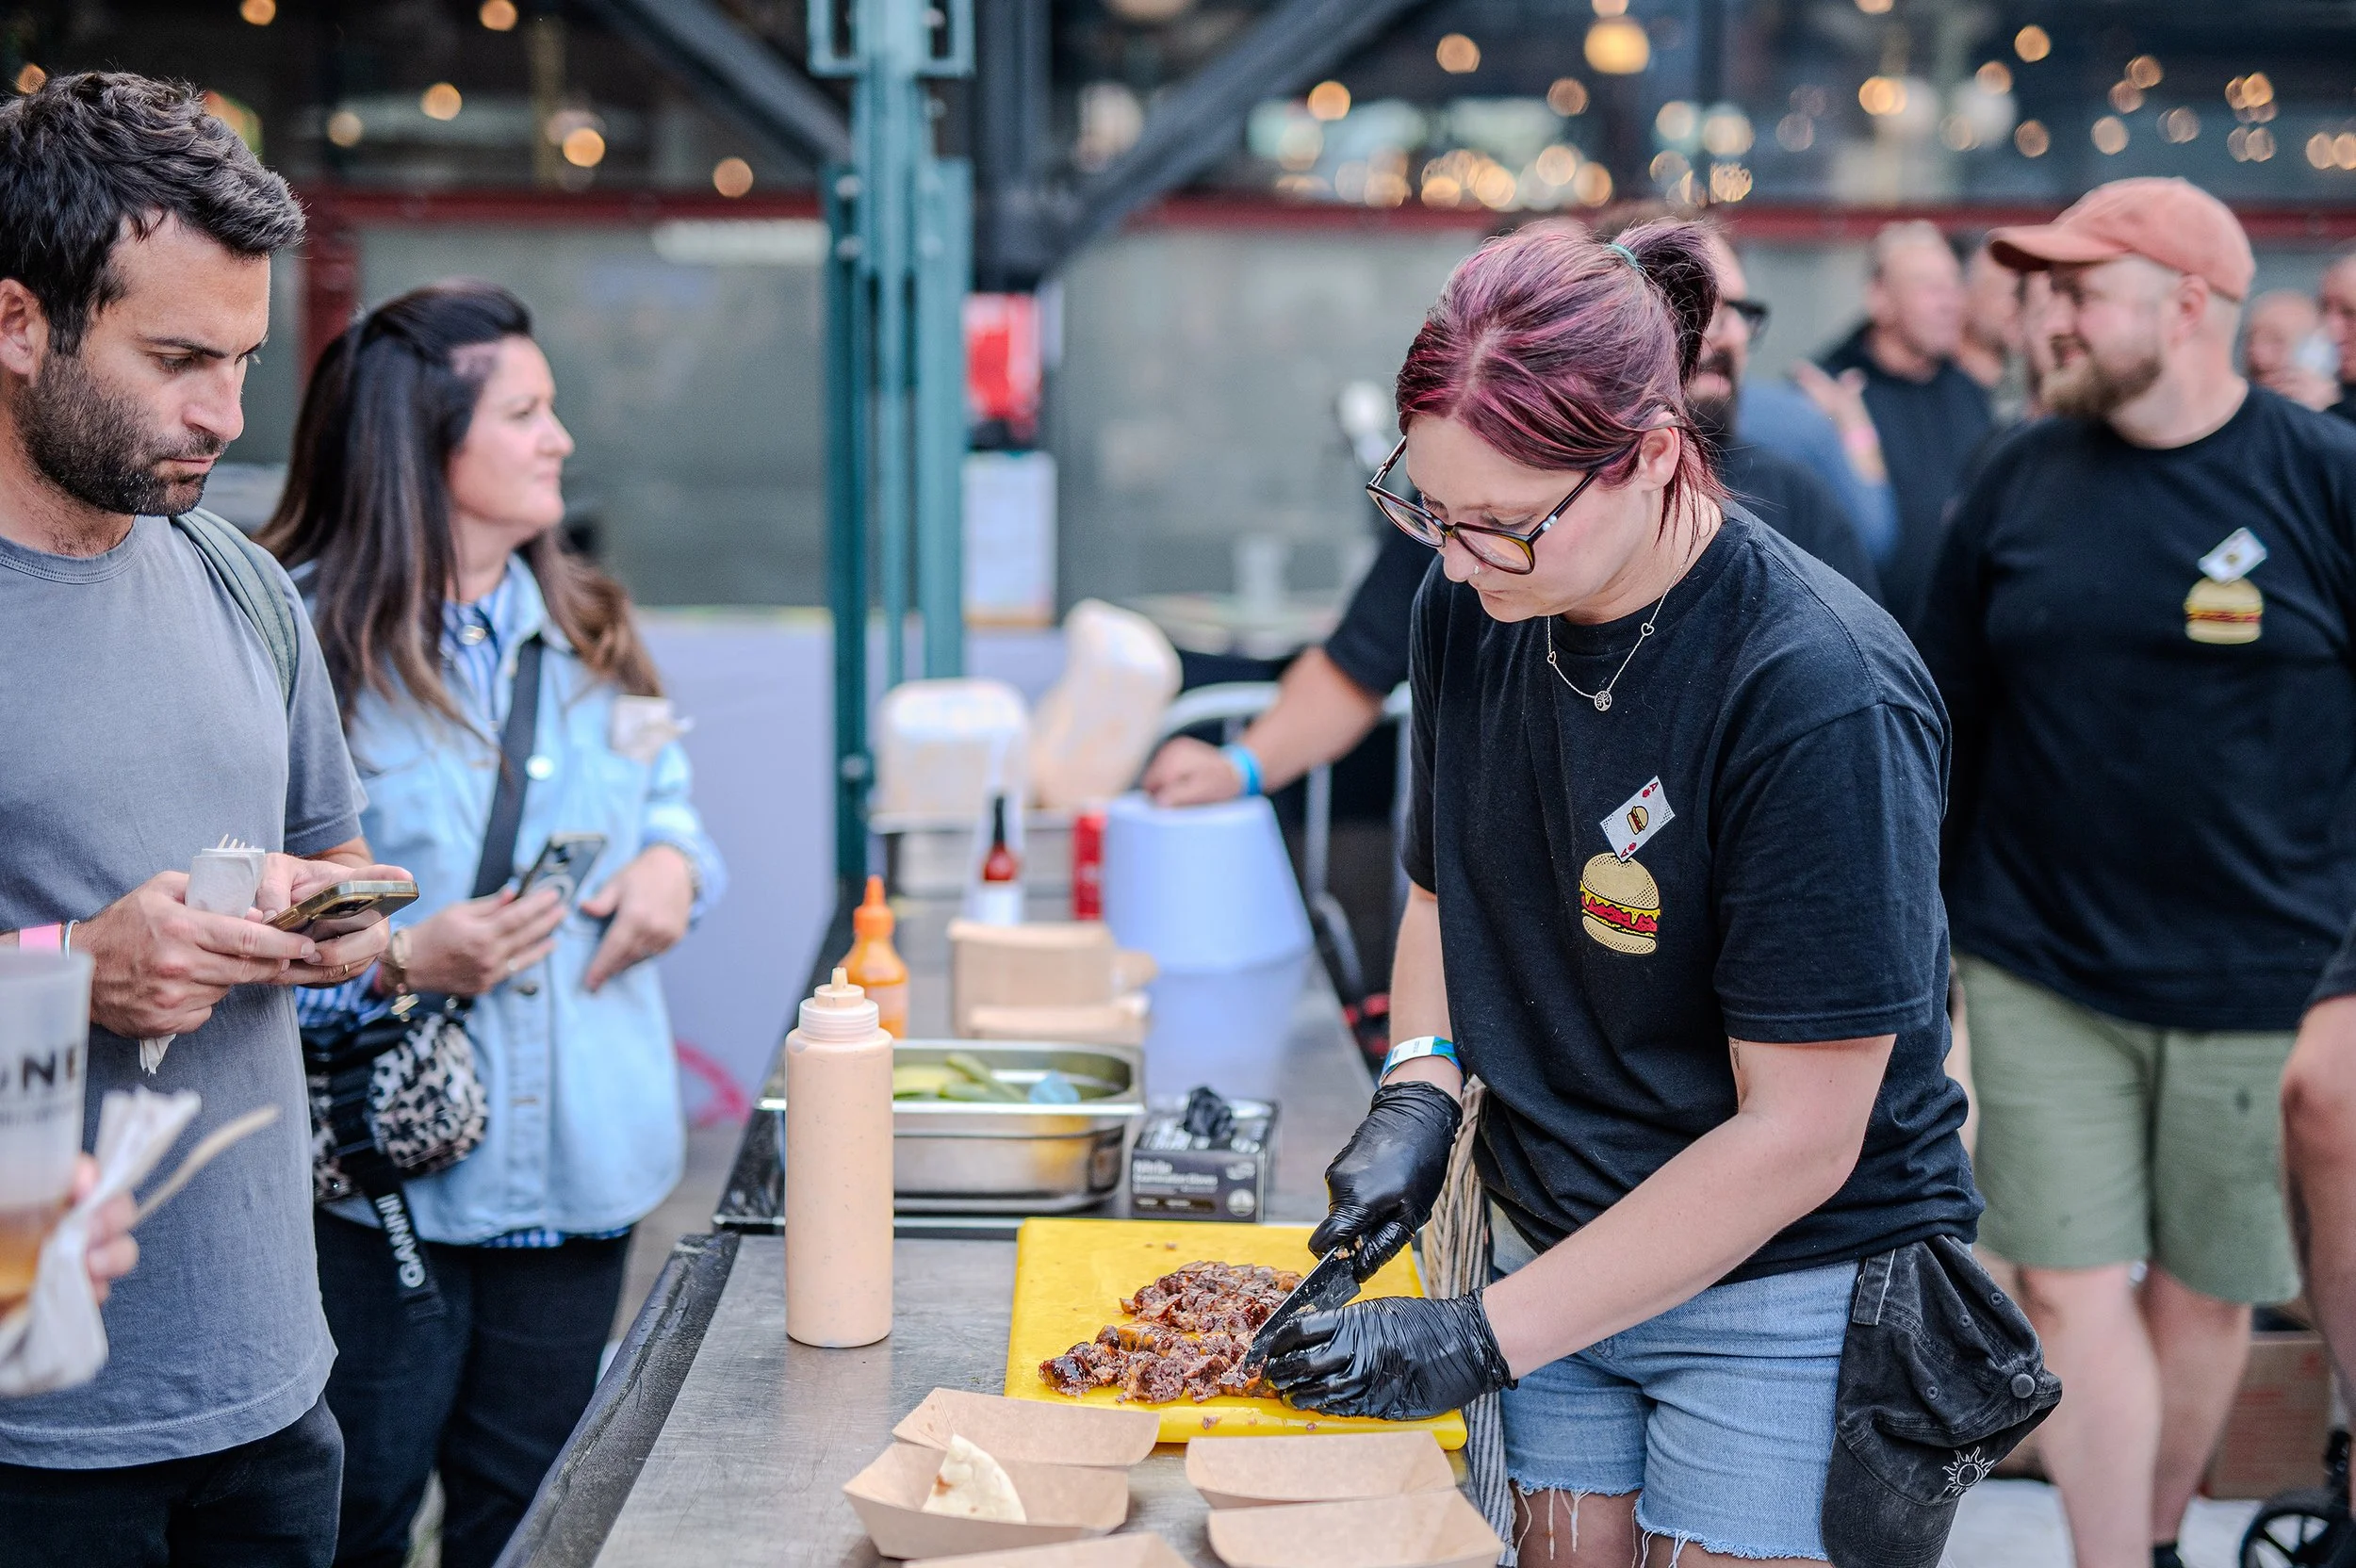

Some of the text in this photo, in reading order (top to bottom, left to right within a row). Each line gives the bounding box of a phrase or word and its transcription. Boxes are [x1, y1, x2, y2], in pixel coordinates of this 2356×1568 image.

[1649, 781, 1659, 792] A
[1620, 848, 1628, 858] A
[375, 1192, 426, 1288] GANNI
